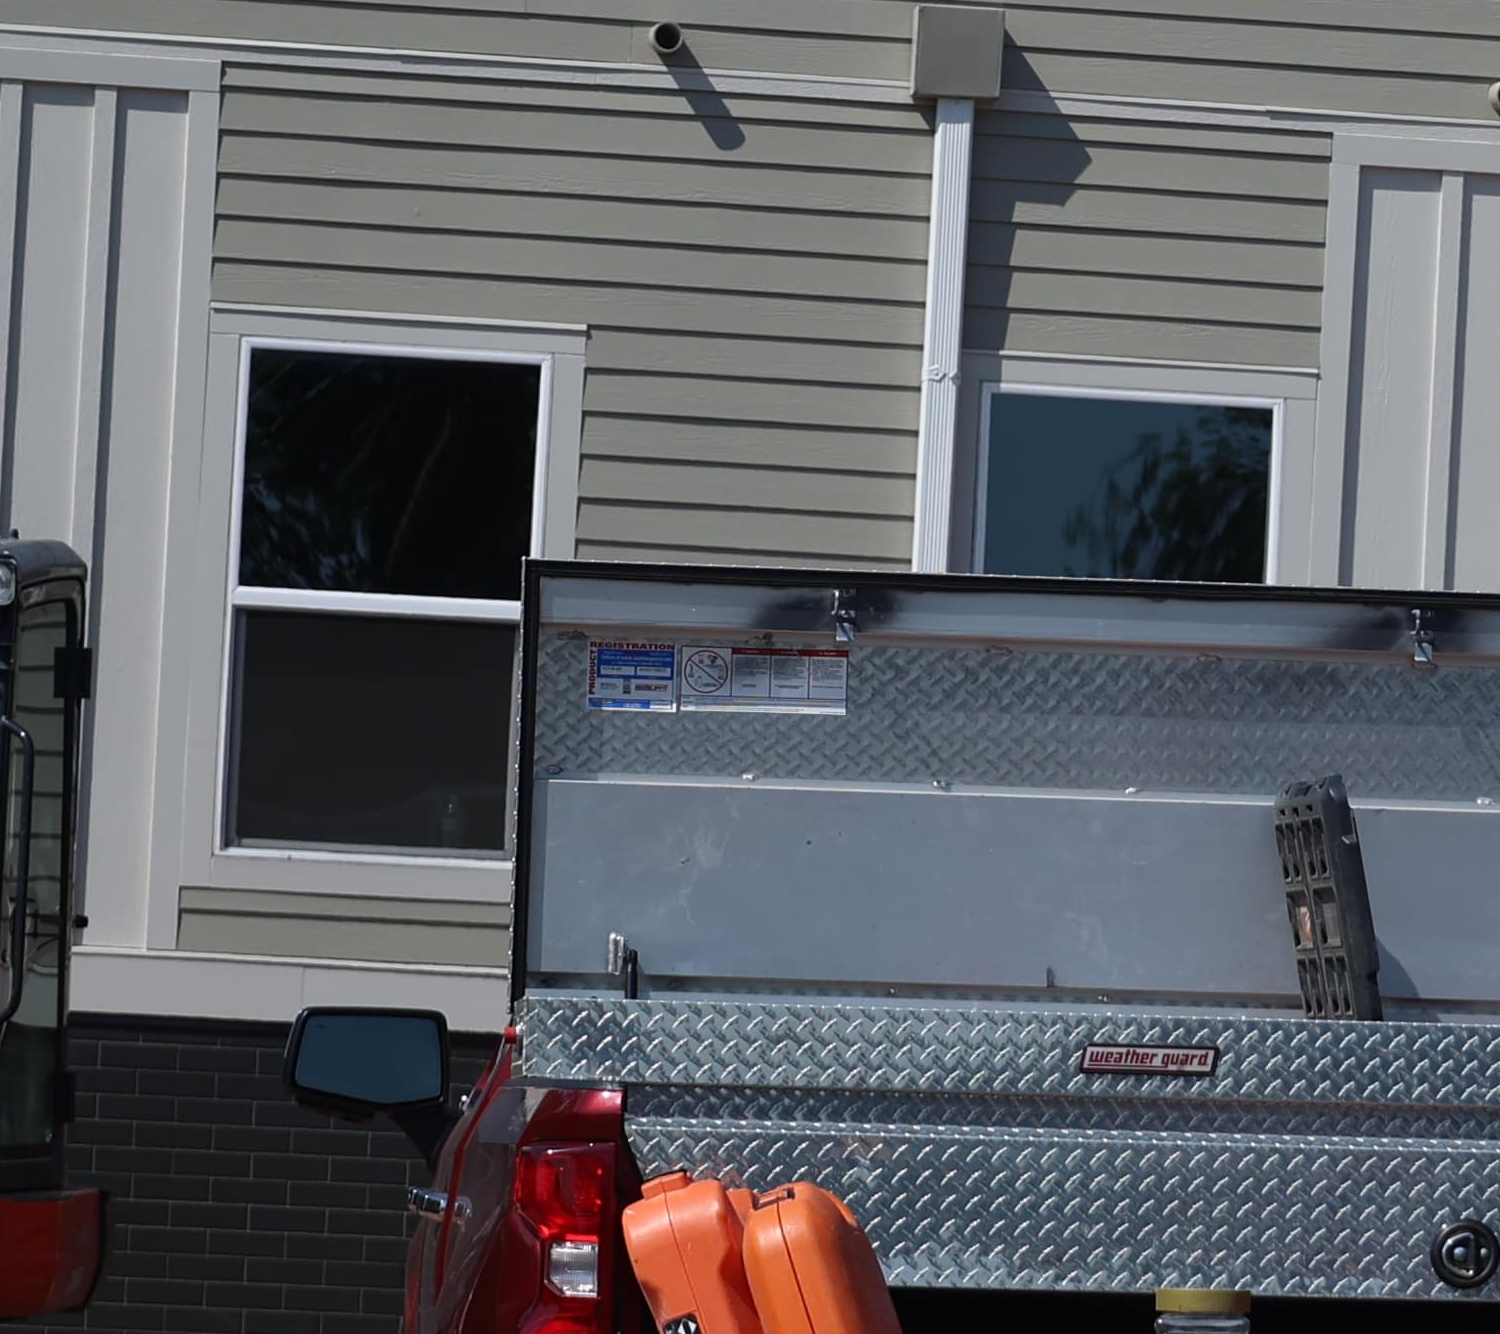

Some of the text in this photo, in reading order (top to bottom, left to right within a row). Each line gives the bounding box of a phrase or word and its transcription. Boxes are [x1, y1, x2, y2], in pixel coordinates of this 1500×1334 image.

[589, 641, 676, 650] REGISTRATION
[588, 649, 596, 695] PRODUCT
[1089, 1049, 1209, 1067] weather guard
